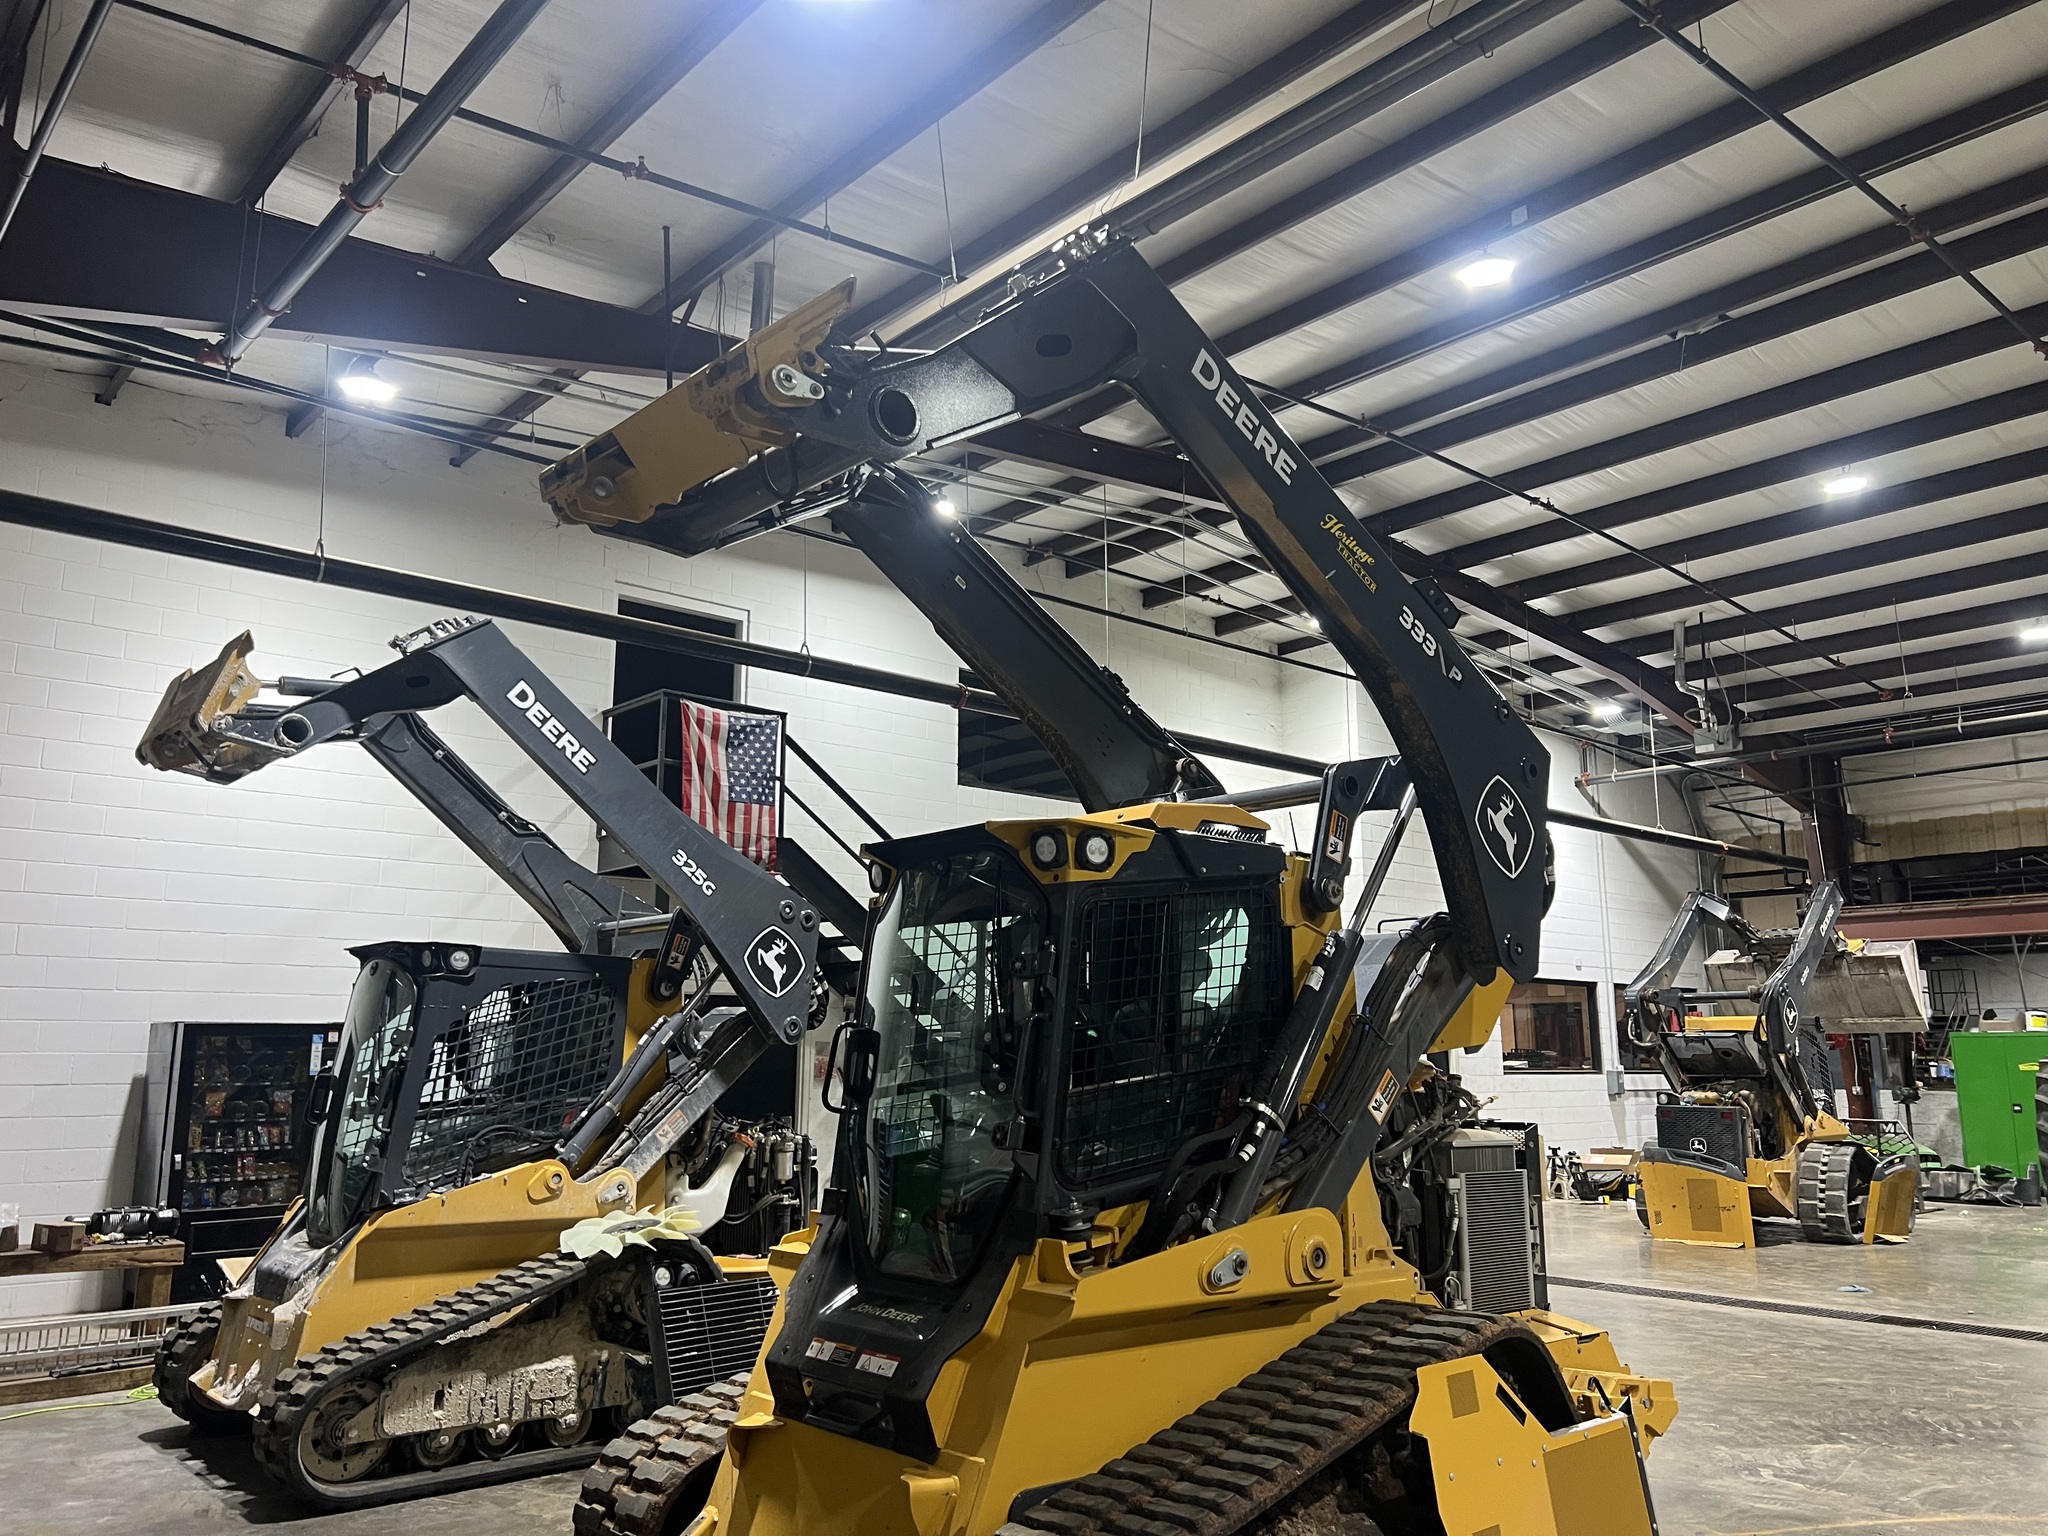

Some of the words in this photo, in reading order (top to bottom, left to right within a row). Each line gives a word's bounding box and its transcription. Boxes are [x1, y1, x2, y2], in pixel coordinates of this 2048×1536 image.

[1191, 347, 1298, 486] DEERE
[1320, 513, 1376, 566] Heritage
[1337, 541, 1378, 593] TRACTOR
[1399, 605, 1438, 657] 333
[1448, 665, 1462, 681] P
[506, 679, 598, 775] DEERE
[671, 848, 716, 896] 325G
[851, 1303, 884, 1316] JOHN
[881, 1308, 924, 1324] DEERE
